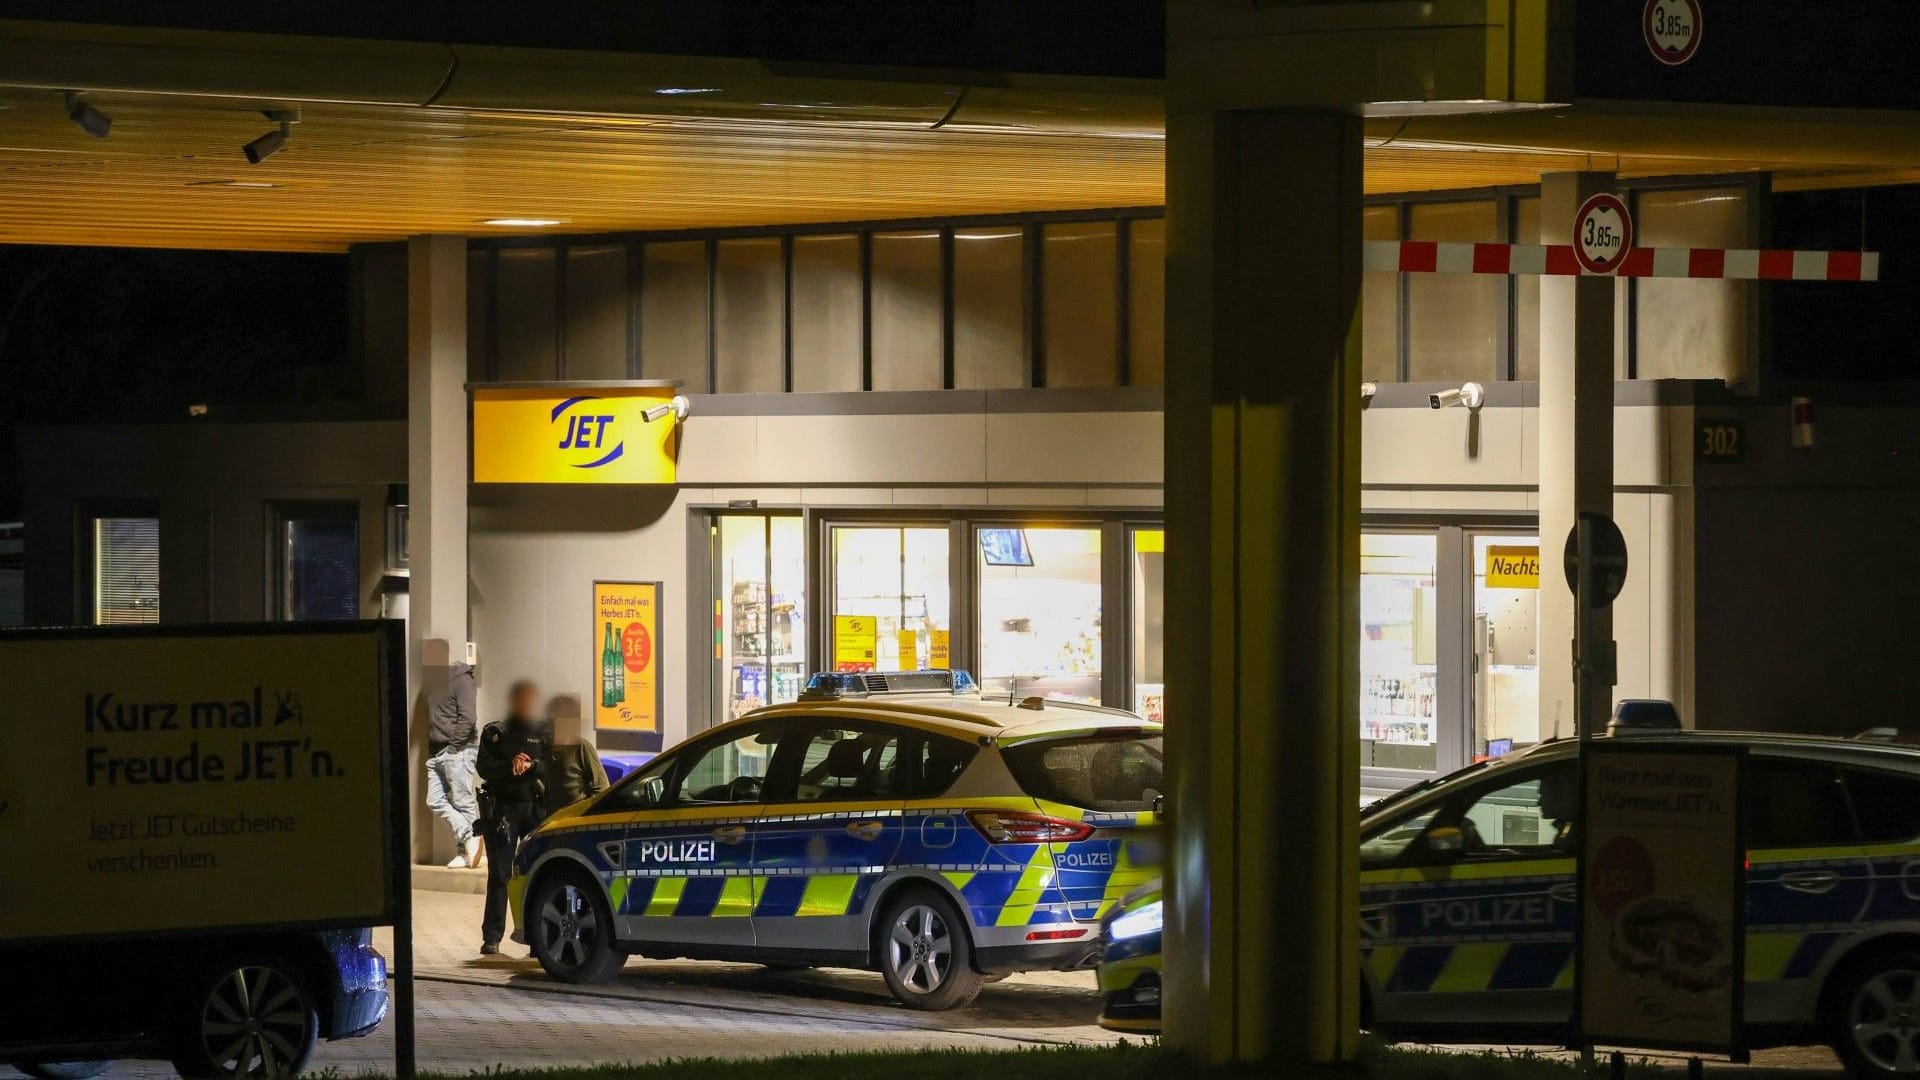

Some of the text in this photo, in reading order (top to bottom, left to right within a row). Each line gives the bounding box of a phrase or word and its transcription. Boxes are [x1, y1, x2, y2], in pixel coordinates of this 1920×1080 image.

[558, 415, 615, 449] JET
[1703, 426, 1738, 456] 302
[600, 595, 650, 607] Einfach mal was
[600, 608, 623, 618] Herbes
[84, 686, 263, 734] Kurz mal
[86, 742, 225, 787] Freude
[88, 812, 296, 841] Jetzt JET Gutscheine
[641, 840, 715, 862] POLIZEI
[1057, 853, 1113, 867] POLIZEI
[1421, 899, 1556, 927] POLIZEI
